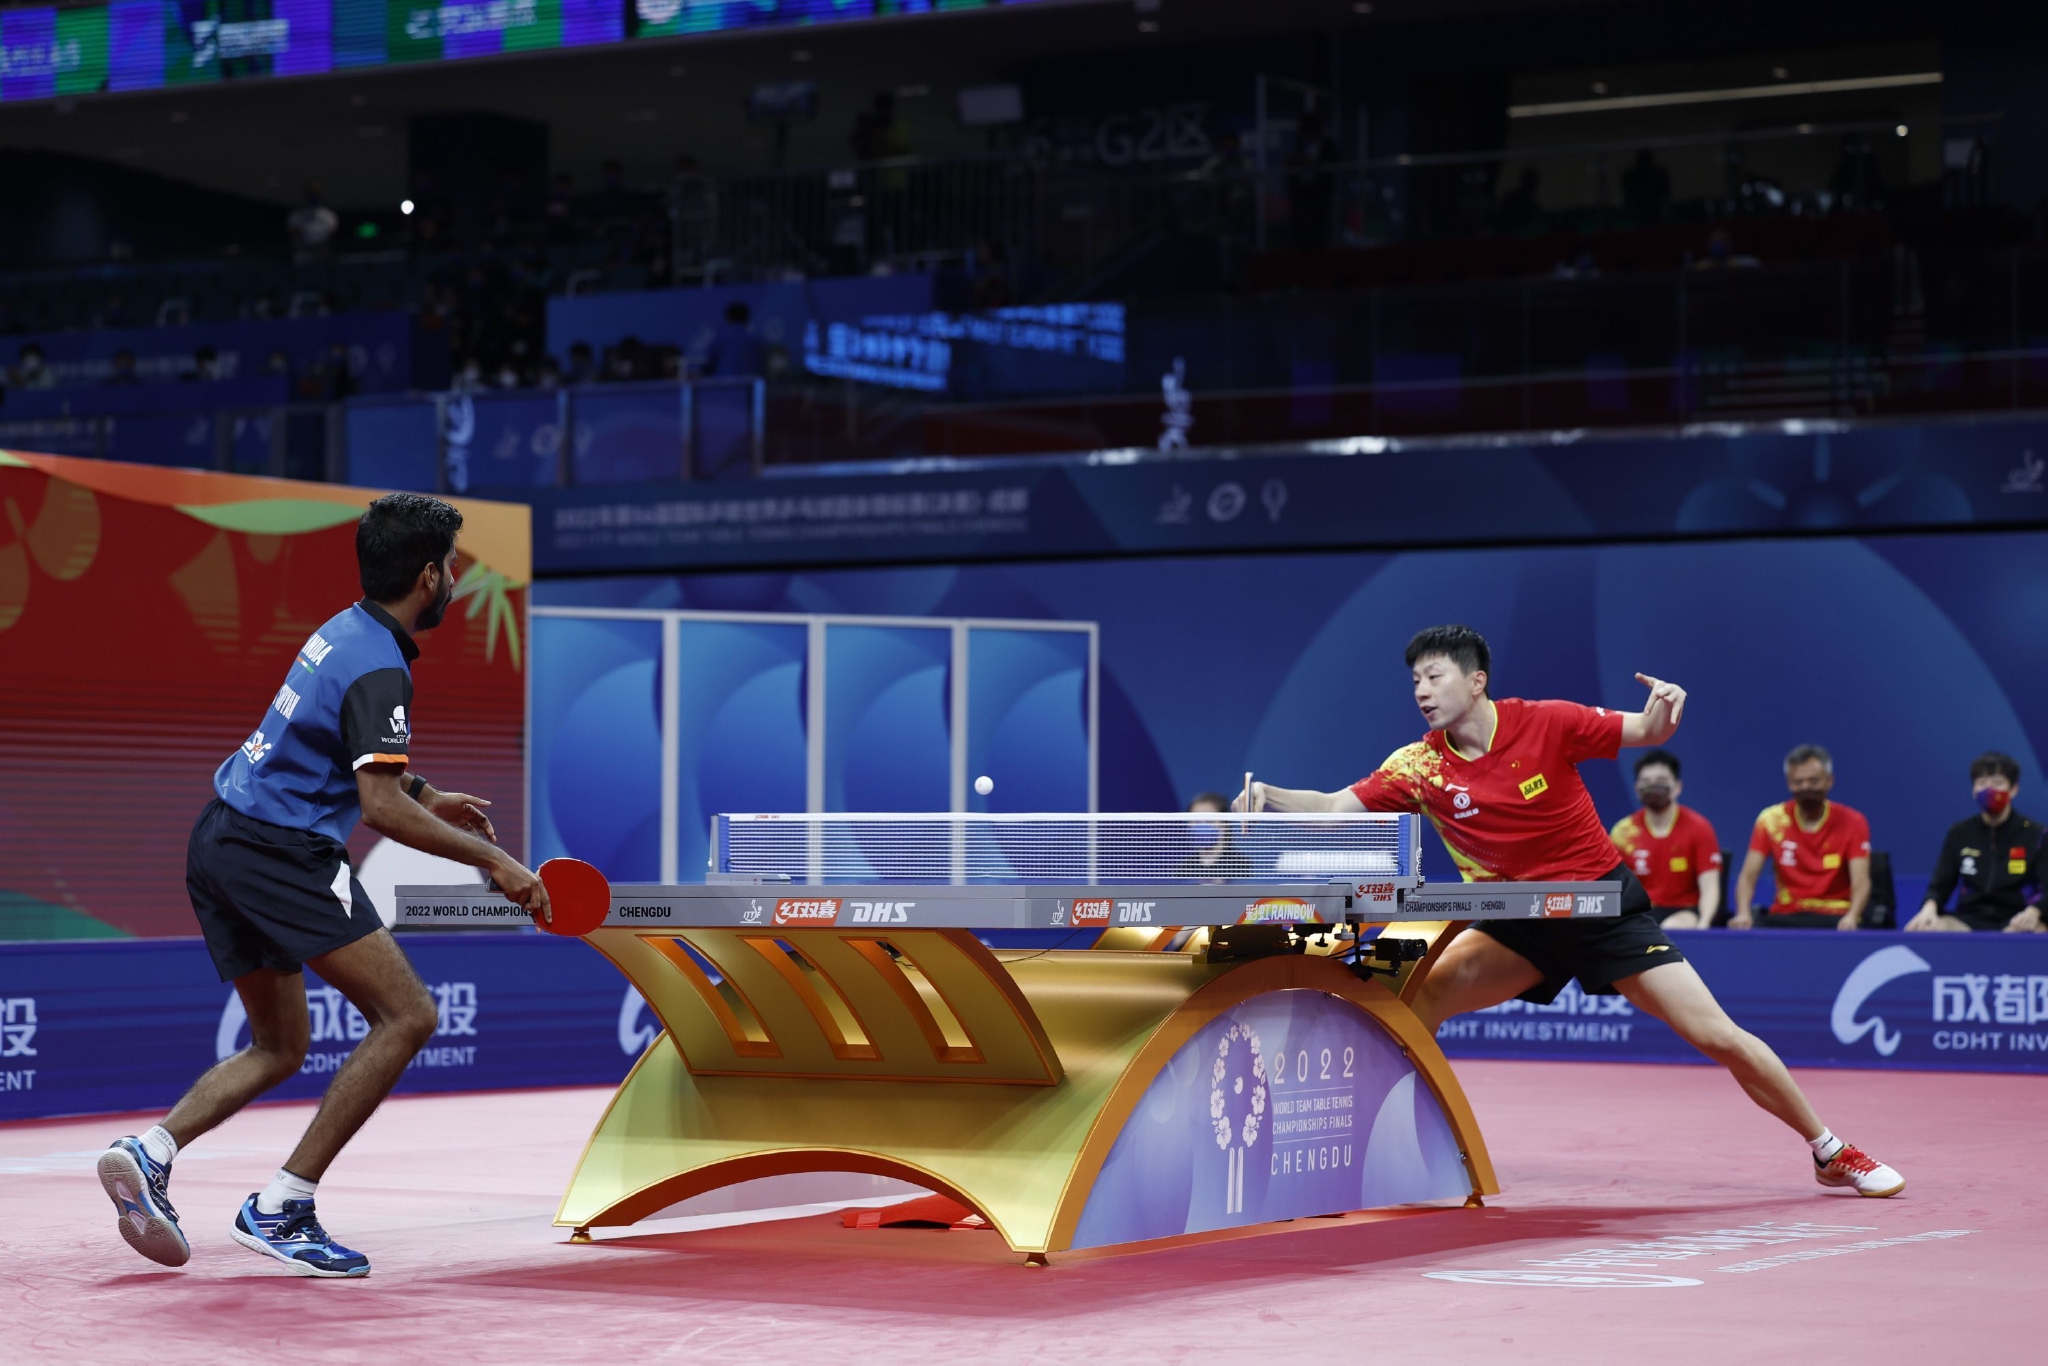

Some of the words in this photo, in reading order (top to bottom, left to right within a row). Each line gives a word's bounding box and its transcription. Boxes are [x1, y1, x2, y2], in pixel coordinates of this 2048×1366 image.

[302, 633, 333, 667] INDIA
[1355, 882, 1395, 898] 红双喜
[406, 905, 430, 917] 2022
[433, 905, 469, 917] WORLD
[619, 906, 671, 918] CHENGDU
[775, 900, 837, 924] 红双喜
[850, 902, 915, 922] DHS
[1072, 900, 1110, 925] 红双喜
[1117, 902, 1156, 922] DHS
[1245, 904, 1270, 921] 彩虹
[1270, 903, 1316, 920] RAINBOW
[1405, 901, 1452, 913] CHAMPIONSHIPS
[1453, 901, 1472, 912] FINALS
[1480, 900, 1506, 911] CHENGDU
[1576, 895, 1605, 914] DHS
[1484, 1020, 1634, 1042] INVESTMENT
[1932, 1030, 2004, 1050] CDHT
[1274, 1046, 1354, 1084] 2022
[1273, 1100, 1294, 1115] WORLD
[1296, 1098, 1312, 1113] TEAM
[1313, 1097, 1330, 1111] TABLE
[1332, 1095, 1353, 1109] TENNIS
[1272, 1117, 1328, 1135] CHAMPIONSHIPS
[1329, 1114, 1353, 1129] FINALS
[1271, 1144, 1352, 1175] CHENGDU
